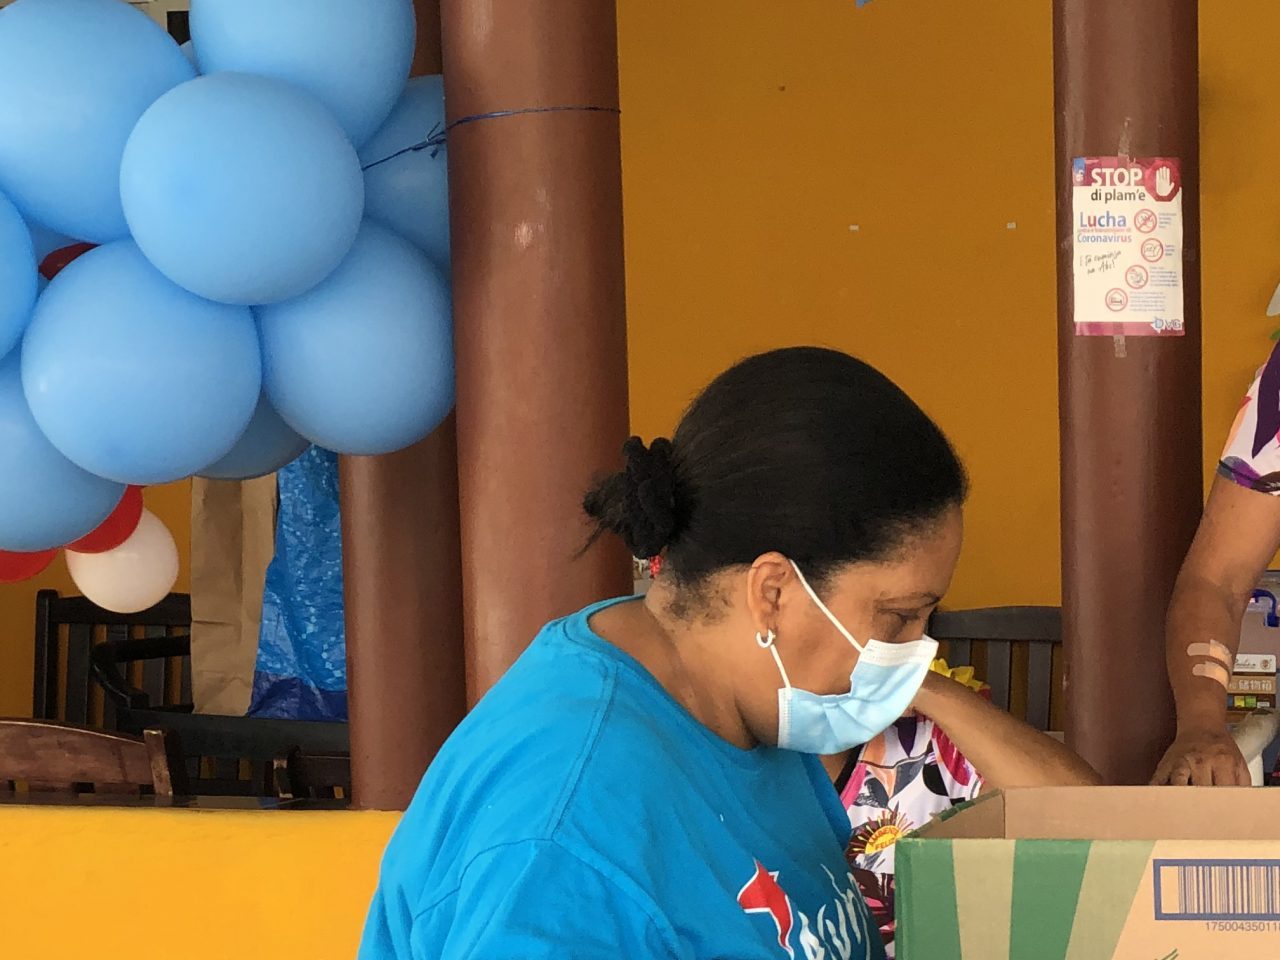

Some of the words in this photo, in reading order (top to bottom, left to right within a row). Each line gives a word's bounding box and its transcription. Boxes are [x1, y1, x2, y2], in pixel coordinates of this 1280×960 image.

[1091, 168, 1143, 187] STOP
[1090, 189, 1102, 201] di
[1104, 189, 1146, 204] plam'e
[1080, 211, 1127, 228] Lucha
[1077, 233, 1132, 243] Coronavirus
